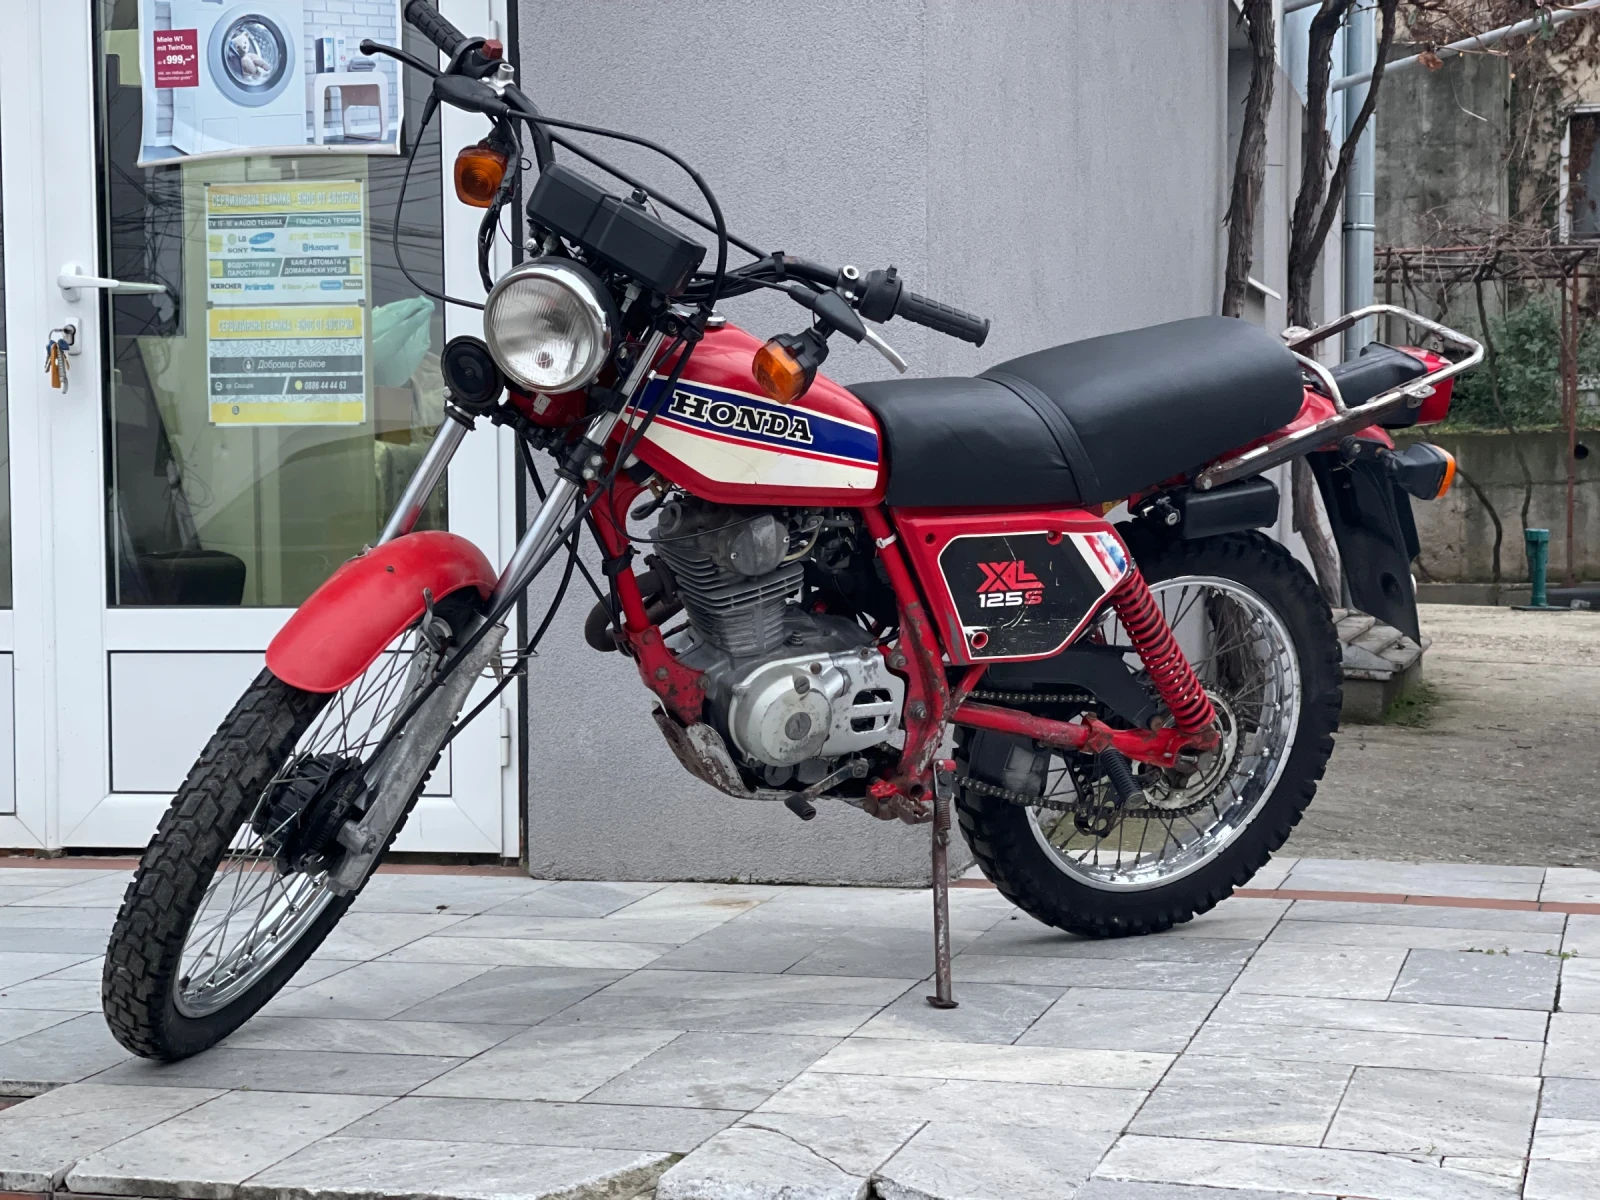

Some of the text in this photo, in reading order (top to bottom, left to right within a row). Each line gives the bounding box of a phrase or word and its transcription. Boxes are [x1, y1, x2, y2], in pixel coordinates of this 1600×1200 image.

[237, 235, 247, 243] LG
[257, 360, 296, 370] Добромир
[668, 389, 813, 444] HONDA
[976, 560, 1045, 593] XL
